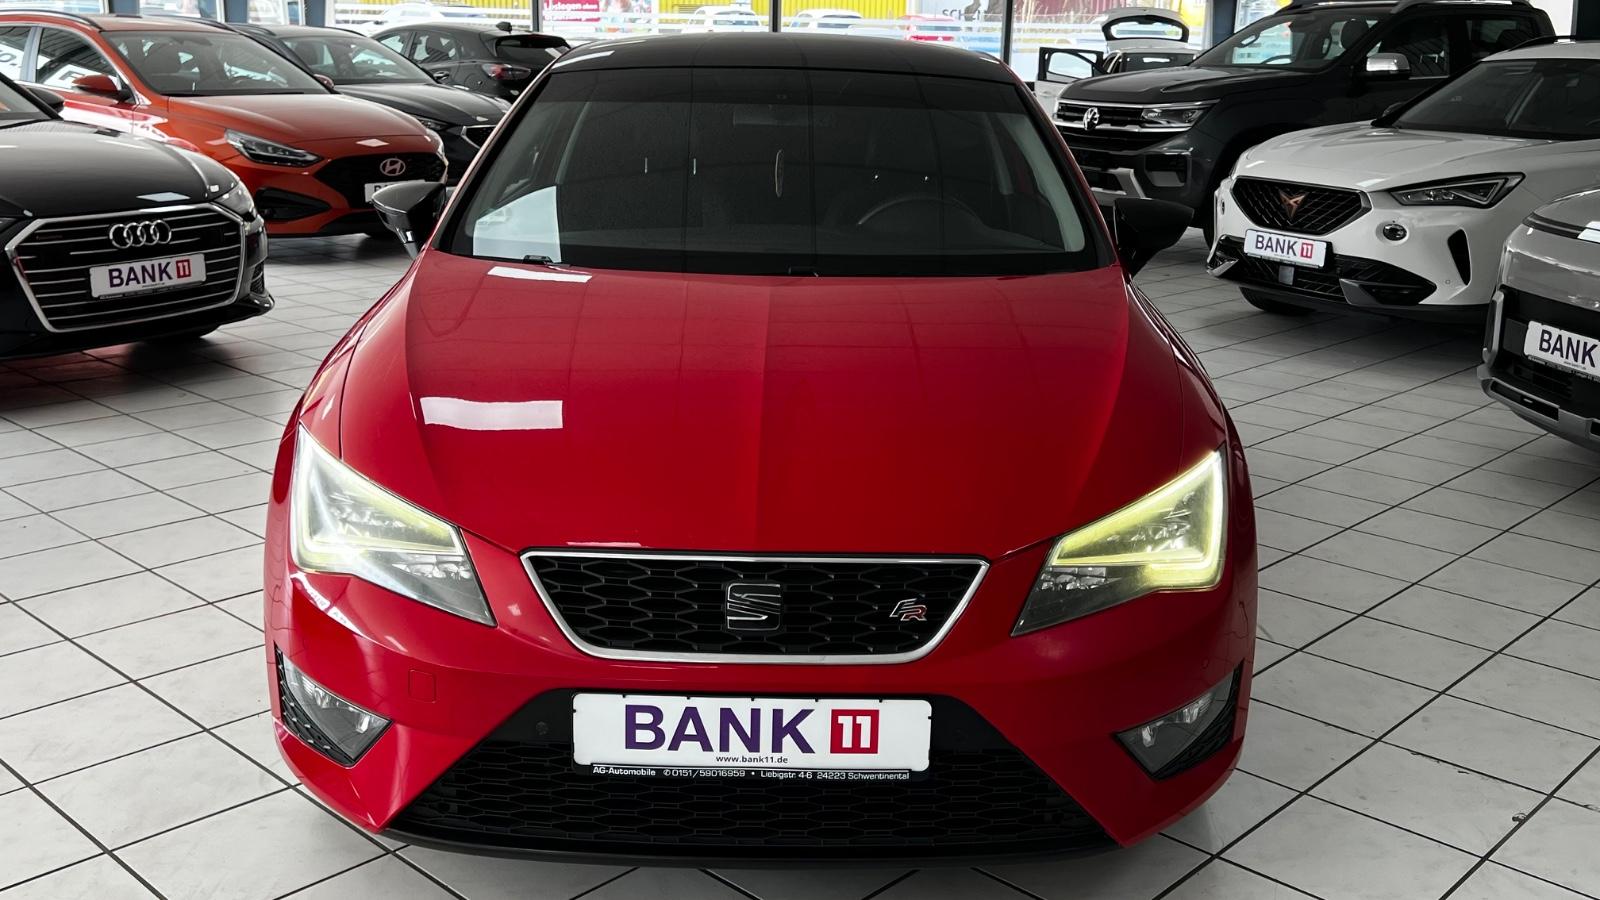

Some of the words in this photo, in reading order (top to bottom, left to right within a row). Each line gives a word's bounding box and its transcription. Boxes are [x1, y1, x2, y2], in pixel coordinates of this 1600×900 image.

[1255, 234, 1298, 257] BANK
[1301, 243, 1313, 259] 11
[108, 261, 173, 288] BANK
[177, 260, 190, 277] 11
[1539, 329, 1598, 369] BANK
[625, 704, 816, 754] BANK
[836, 713, 873, 750] 11
[716, 755, 788, 764] www.bank11.de
[592, 767, 656, 776] AG-Automobile
[847, 773, 910, 781] Schwentinental
